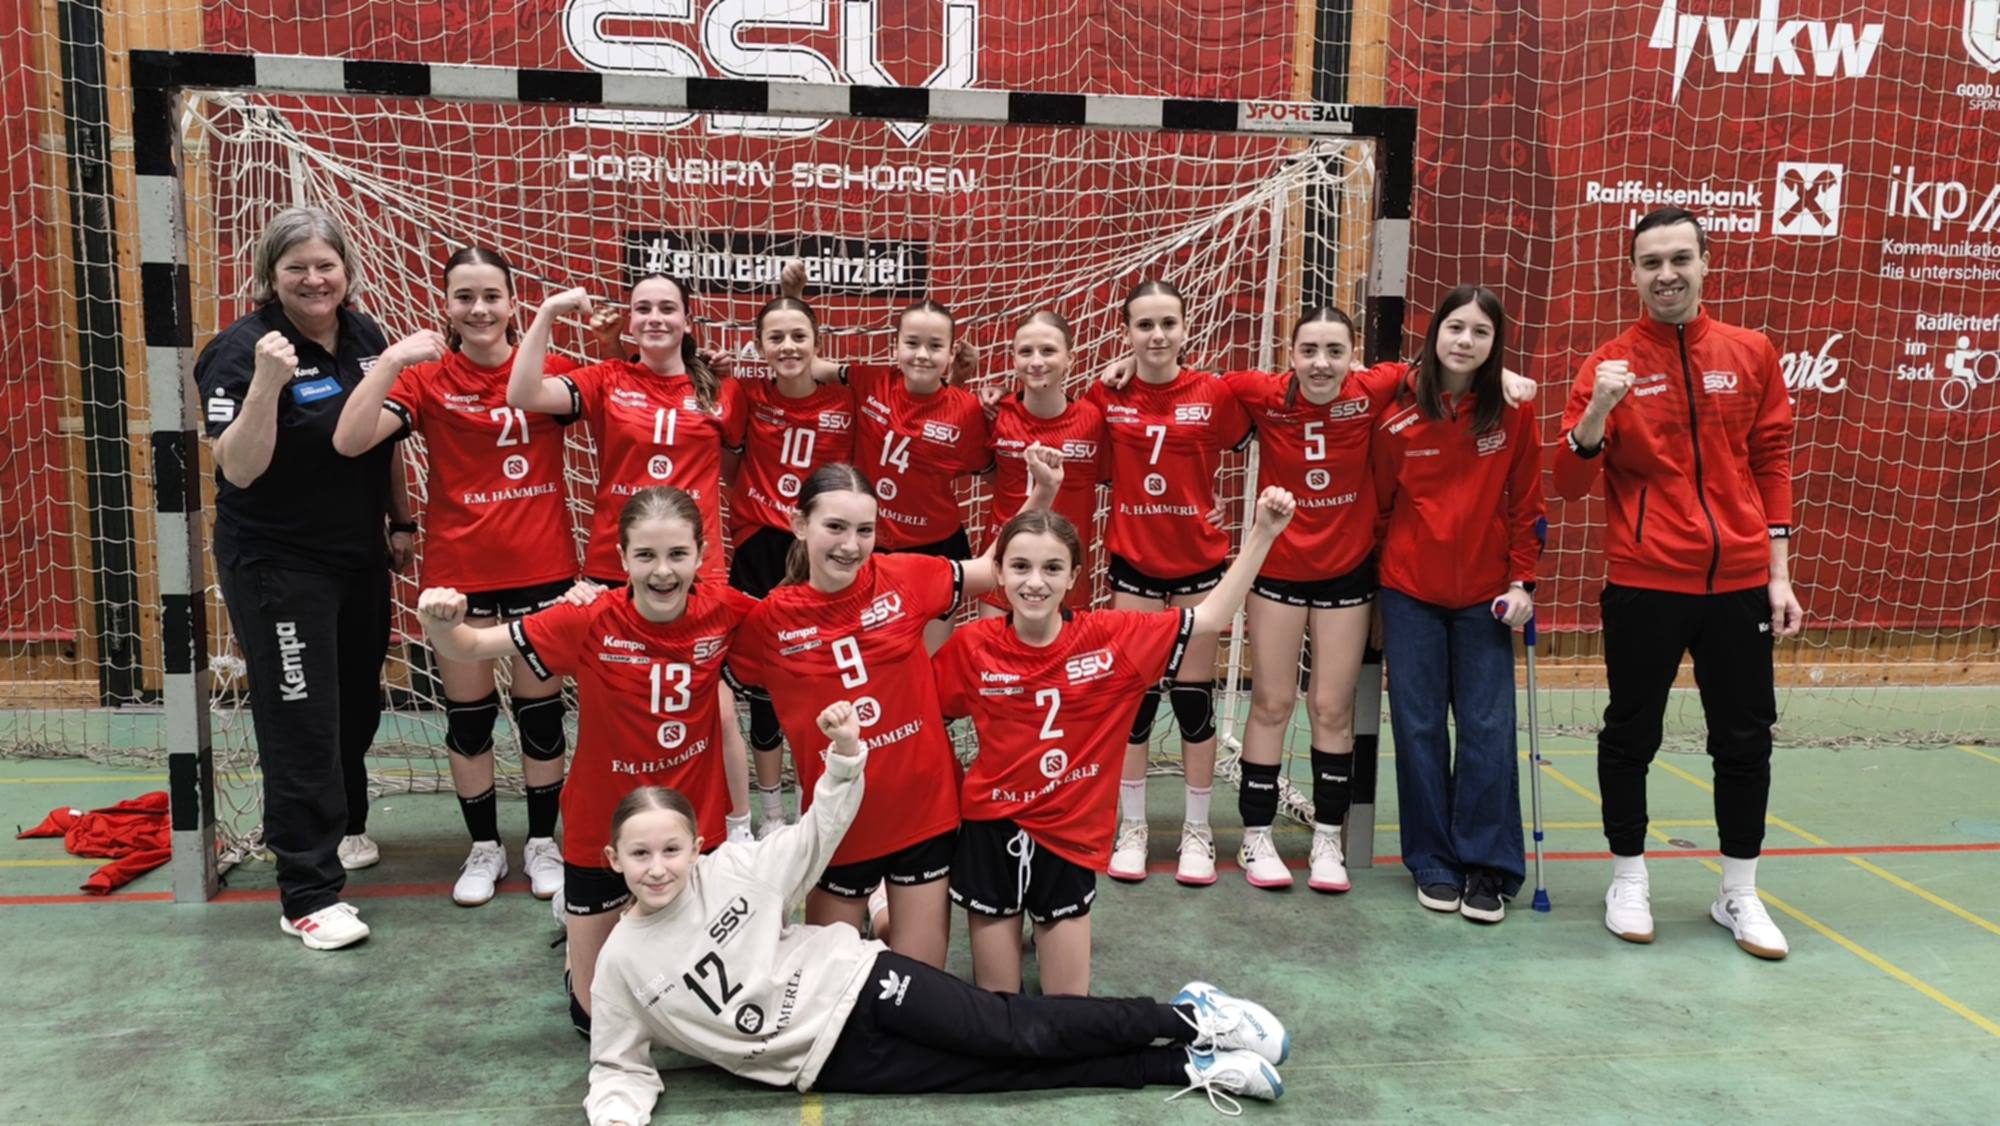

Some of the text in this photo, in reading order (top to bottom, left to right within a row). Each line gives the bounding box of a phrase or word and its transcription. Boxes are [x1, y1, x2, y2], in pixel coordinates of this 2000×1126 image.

[1706, 0, 1884, 78] vkw
[562, 0, 979, 147] SSV
[1956, 83, 1994, 98] GOOD
[568, 153, 977, 195] DORNBIRN SCHOREN
[1586, 181, 1762, 208] Raiffeisenbank
[1881, 263, 1905, 279] die
[1905, 337, 1927, 356] im
[1897, 362, 1934, 381] Sack
[443, 391, 480, 404] Kempa
[1329, 399, 1369, 418] SSV
[490, 406, 529, 448] 21
[653, 408, 676, 446] 11
[818, 413, 850, 430] SSV
[1174, 406, 1212, 422] SSV
[922, 423, 960, 444] SSV
[1145, 425, 1167, 465] 7
[1304, 421, 1326, 461] 5
[780, 427, 816, 468] 10
[879, 429, 912, 475] 14
[1062, 443, 1097, 458] SSV
[463, 493, 490, 504] F.M.
[860, 594, 901, 627] SSV
[510, 620, 527, 647] Kempa
[603, 635, 646, 652] Kempa
[777, 626, 818, 643] Kempa
[277, 621, 308, 701] Kempa
[526, 652, 547, 678] Kempa
[831, 635, 869, 689] 9
[1065, 652, 1114, 680] SSV
[1168, 643, 1184, 671] Kempa
[649, 663, 691, 714] 13
[980, 671, 1021, 684] Kempa
[1035, 688, 1064, 740] 2
[611, 760, 640, 774] F.M.
[1321, 772, 1348, 782] Kempa
[1248, 781, 1274, 790] Kempa
[709, 896, 749, 945] SSV
[682, 951, 744, 1016] 12
